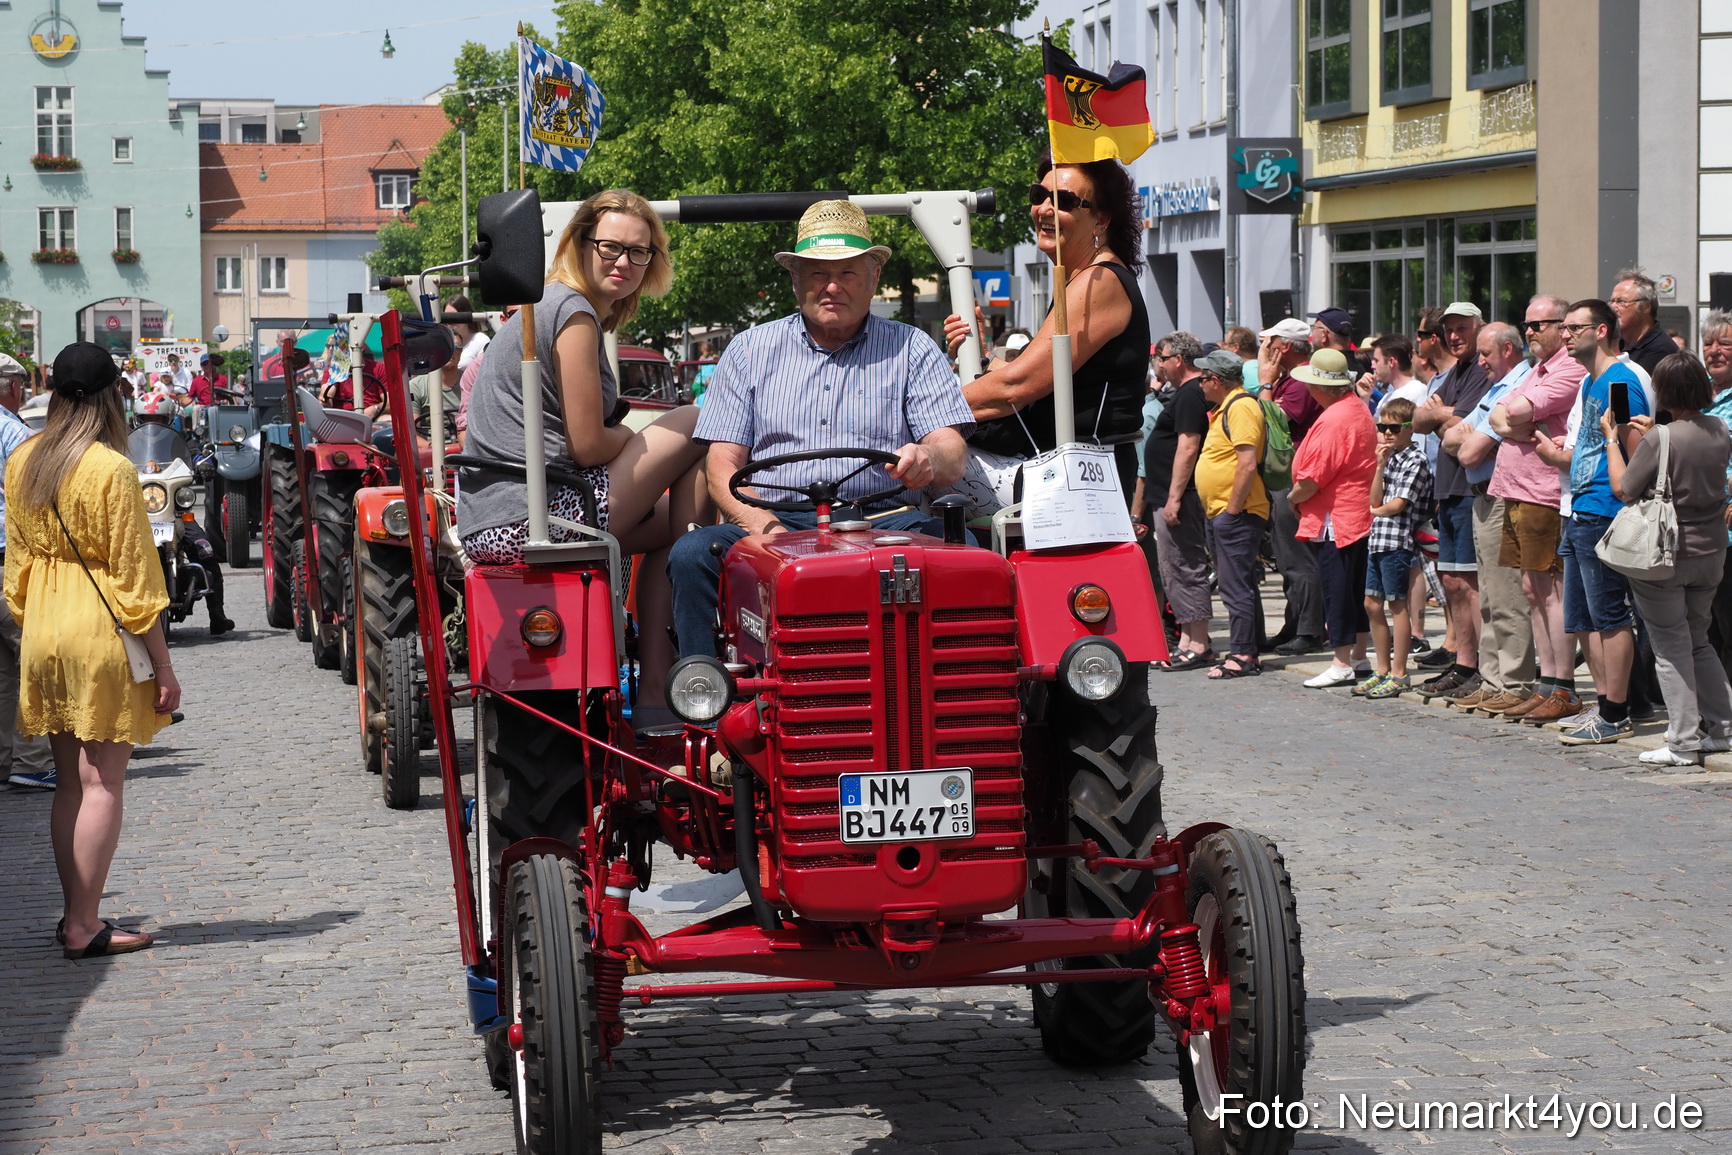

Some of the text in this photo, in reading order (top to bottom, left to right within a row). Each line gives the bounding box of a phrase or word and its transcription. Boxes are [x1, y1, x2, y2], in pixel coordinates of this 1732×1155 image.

[1255, 158, 1281, 189] G2
[1078, 460, 1105, 483] 289
[847, 794, 856, 804] D
[870, 777, 910, 806] NM
[951, 802, 969, 815] 05
[846, 807, 946, 838] BJ447
[952, 820, 969, 833] 09
